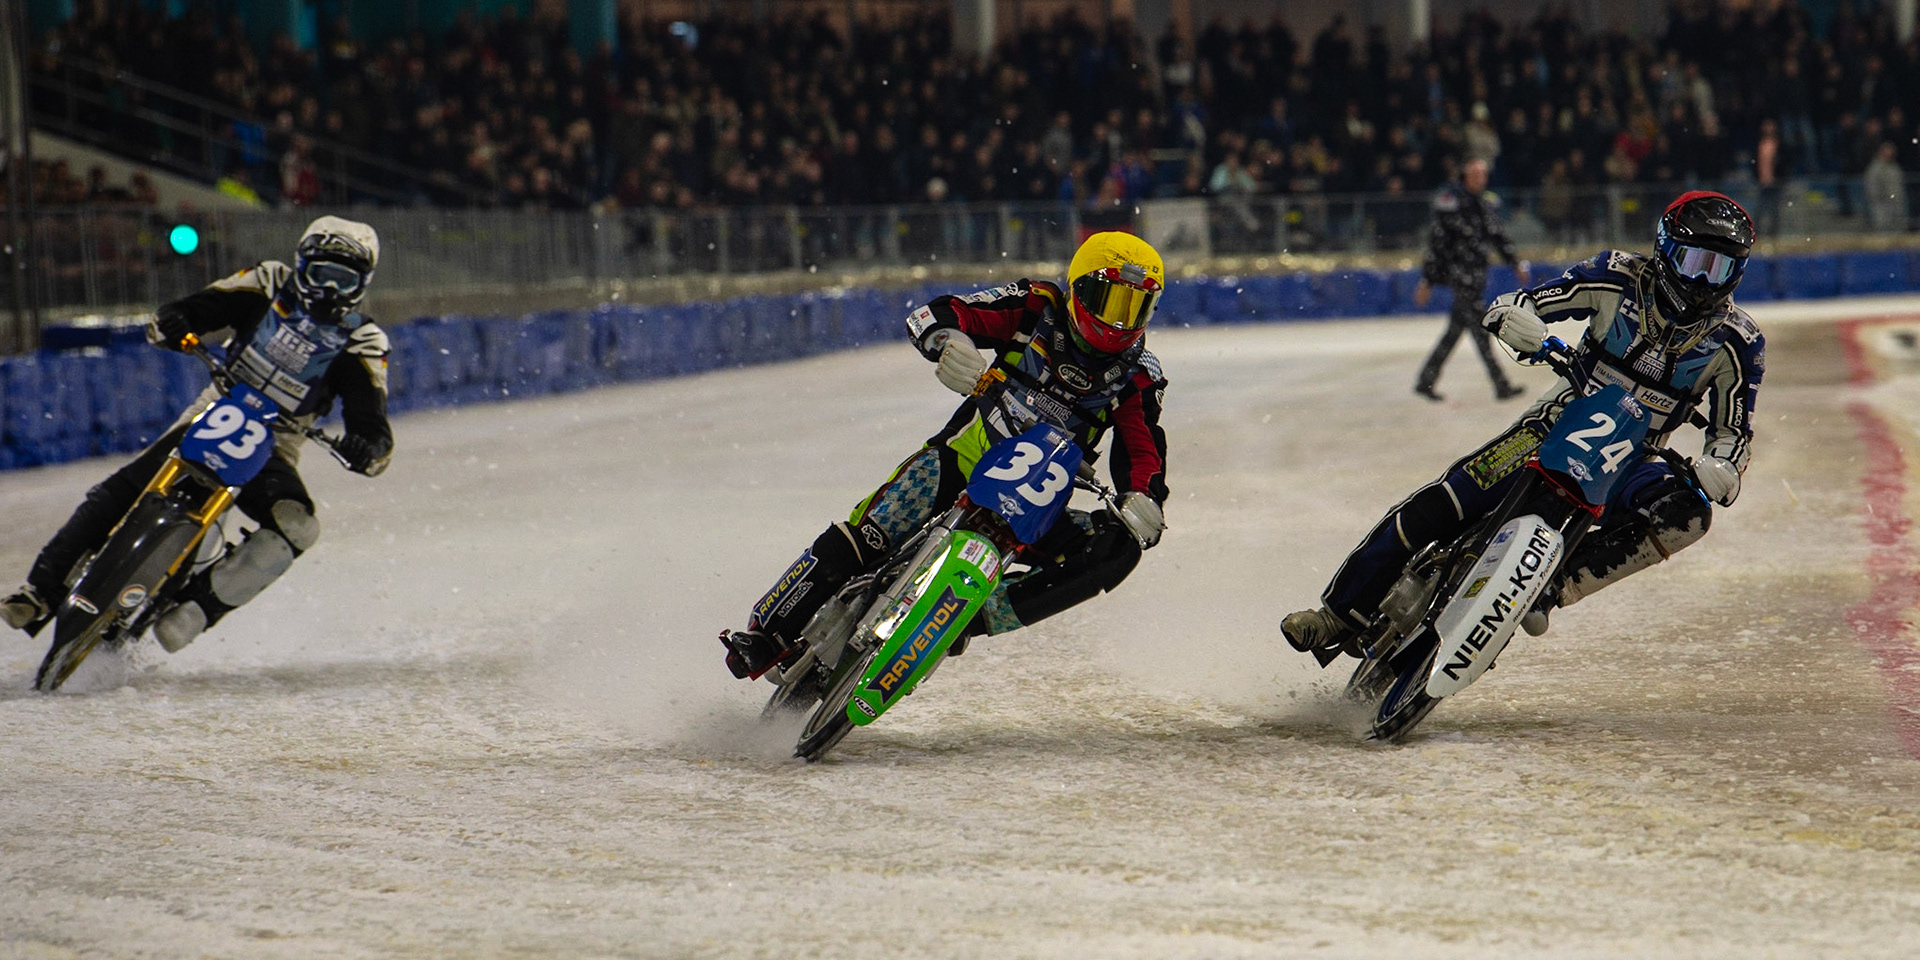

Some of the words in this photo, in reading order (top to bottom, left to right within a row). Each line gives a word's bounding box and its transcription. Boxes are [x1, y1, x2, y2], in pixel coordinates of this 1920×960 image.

[1533, 287, 1563, 300] WACO
[1641, 390, 1673, 409] Hertz
[1734, 397, 1743, 427] WACO
[193, 405, 267, 460] 93
[1565, 412, 1634, 474] 24
[983, 441, 1069, 507] 33
[759, 559, 811, 616] RAVENOL
[778, 580, 814, 618] MOTORÖL
[1513, 604, 1527, 623] more
[880, 601, 959, 691] RAVENOL
